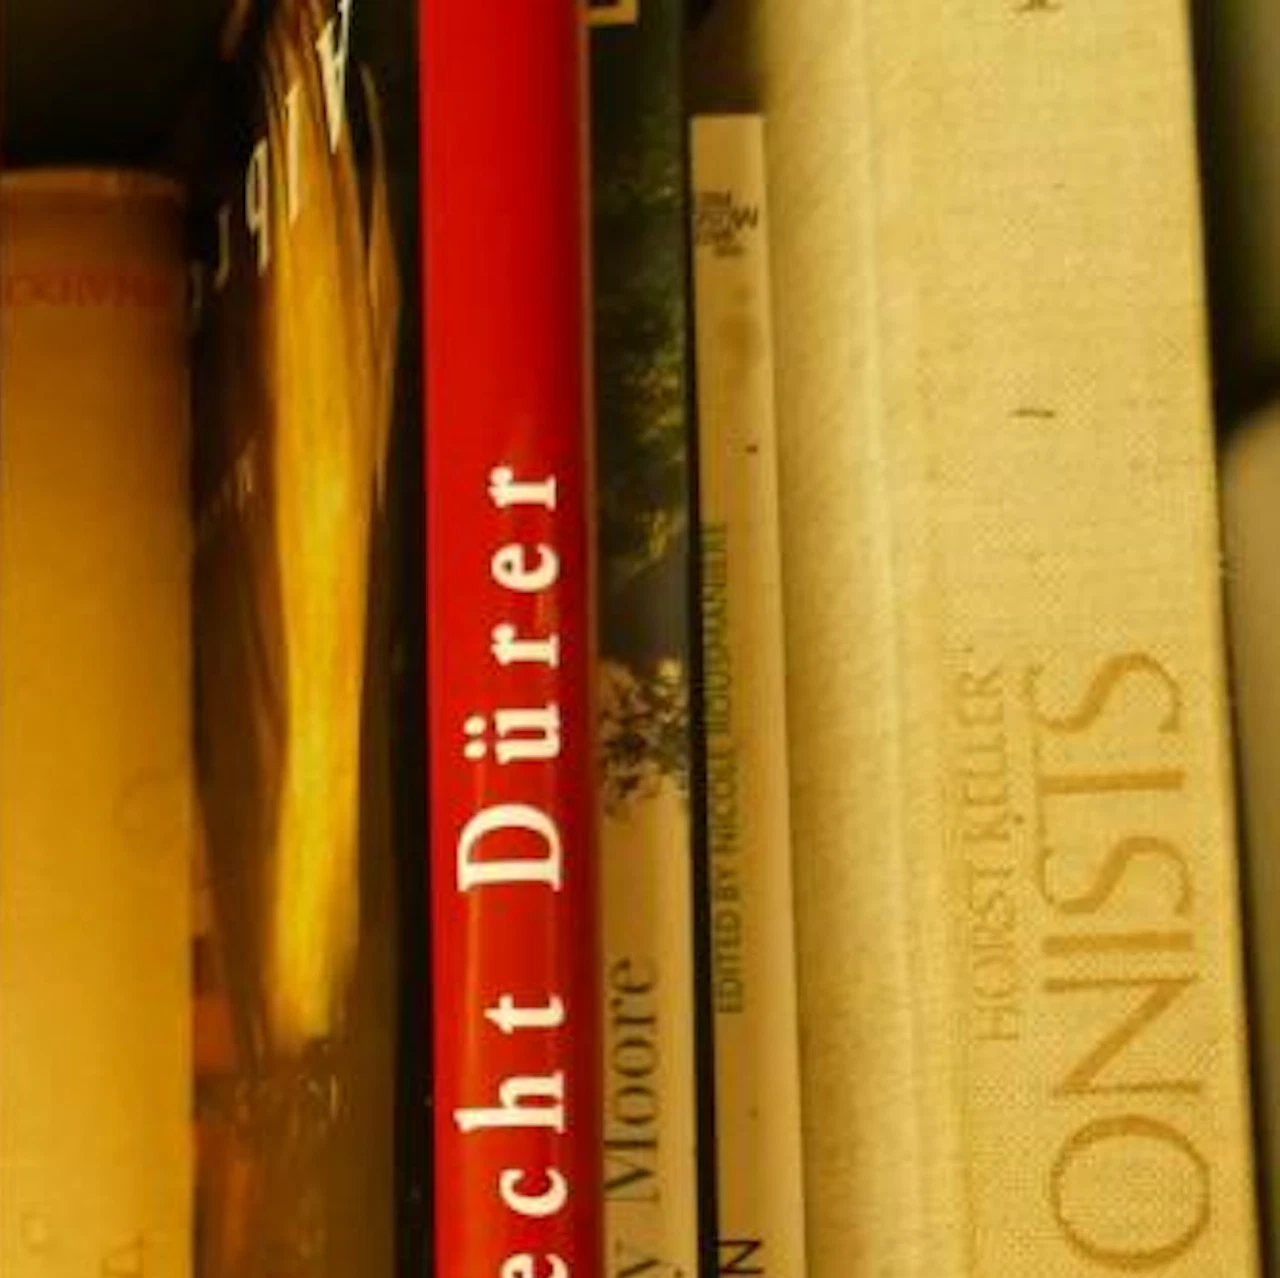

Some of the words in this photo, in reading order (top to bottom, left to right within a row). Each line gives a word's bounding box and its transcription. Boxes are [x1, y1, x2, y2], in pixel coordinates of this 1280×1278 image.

[455, 463, 564, 894] Dürer
[969, 864, 1020, 1041] HORST
[602, 955, 665, 1206] Moore
